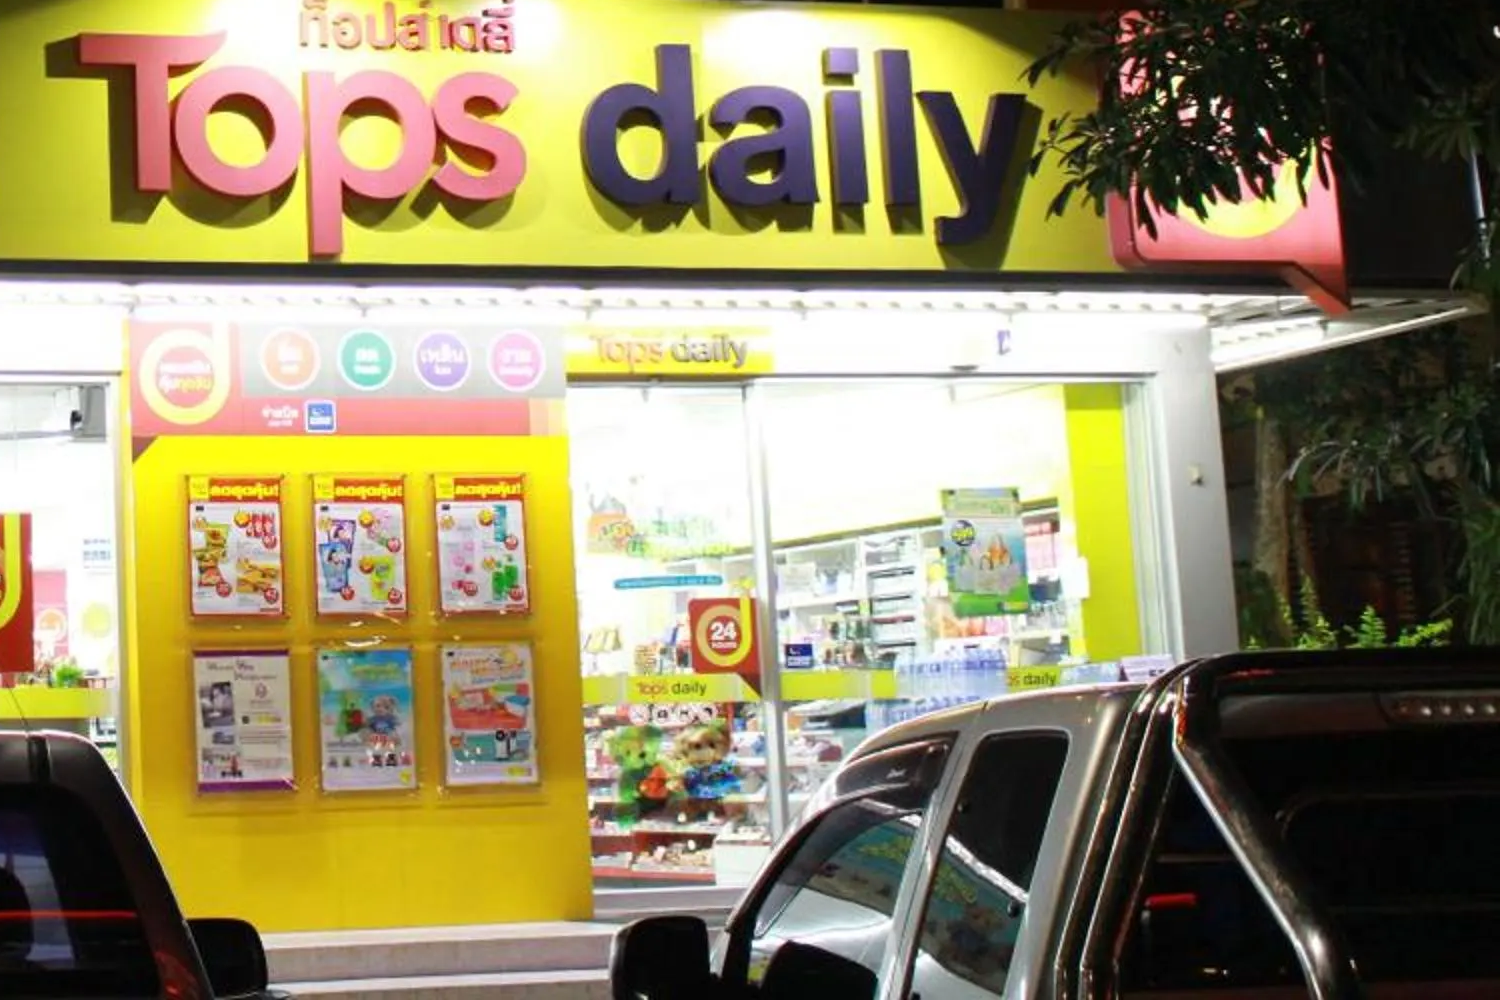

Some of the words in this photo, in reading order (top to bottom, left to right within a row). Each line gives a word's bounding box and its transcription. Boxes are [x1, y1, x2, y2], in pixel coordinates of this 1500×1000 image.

[79, 29, 528, 258] Tops
[579, 43, 1028, 246] daily
[589, 334, 663, 372] Tops
[670, 332, 748, 368] daily
[711, 621, 737, 640] 24
[1023, 671, 1057, 686] daily
[636, 682, 668, 698] Tops
[671, 679, 707, 696] daily
